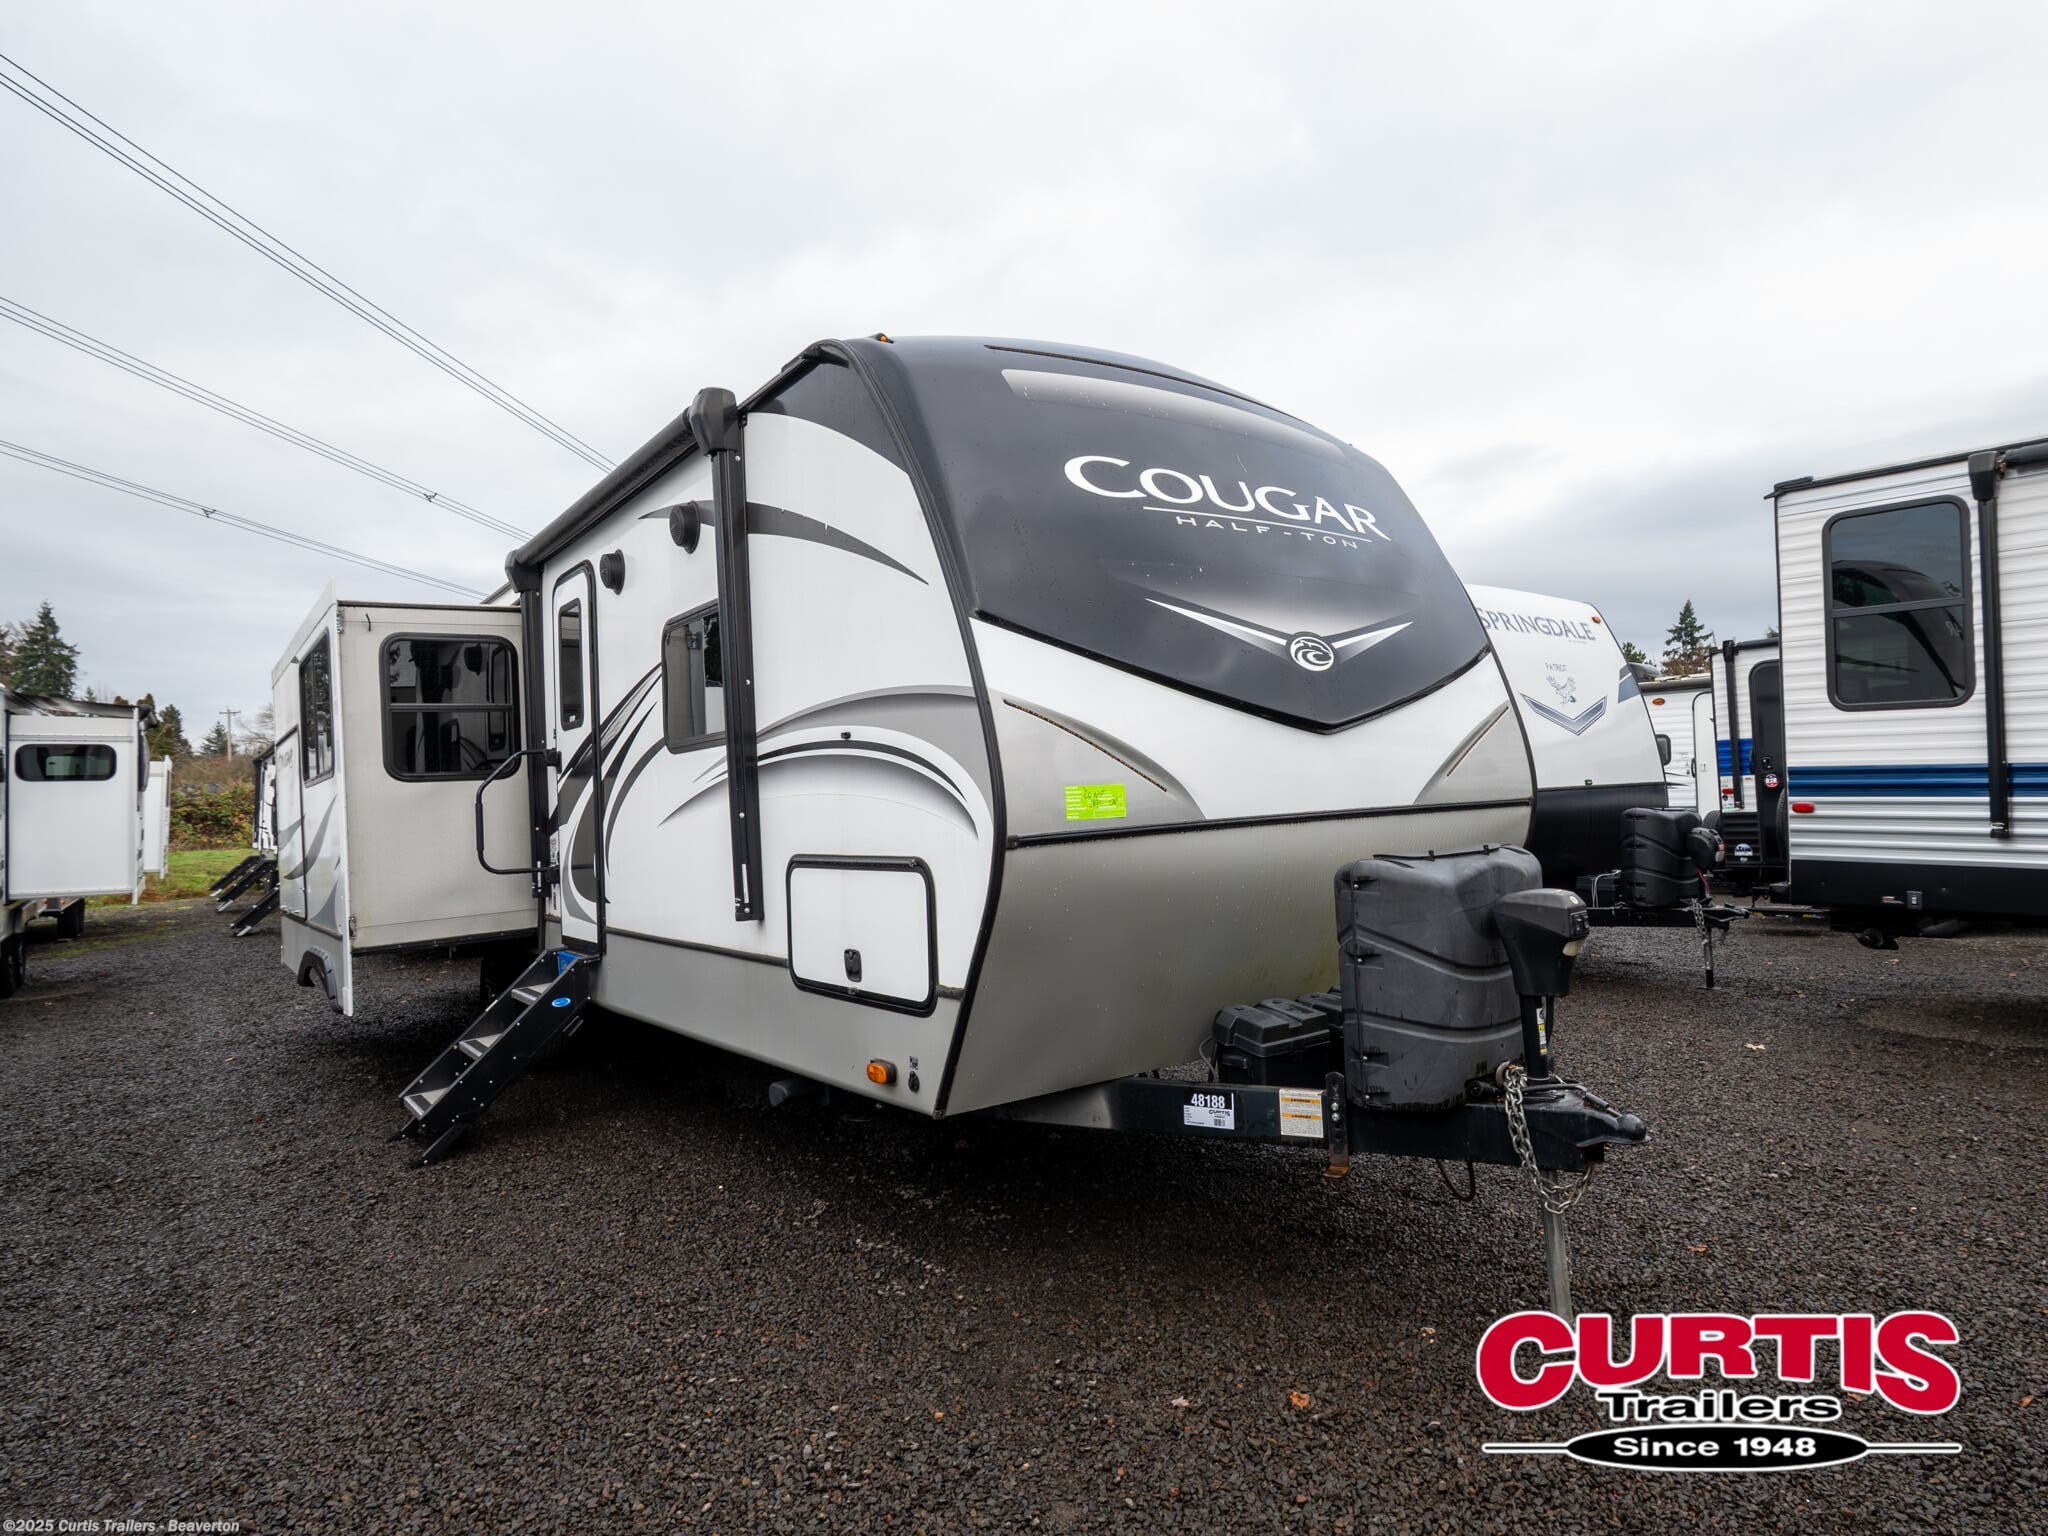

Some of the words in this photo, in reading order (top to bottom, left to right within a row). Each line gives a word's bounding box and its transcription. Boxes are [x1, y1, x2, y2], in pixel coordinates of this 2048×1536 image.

[1064, 455, 1392, 542] COUGAR
[1175, 516, 1358, 549] HALF-TON
[1190, 1093, 1226, 1109] 48188
[1208, 1109, 1231, 1117] CURTIS
